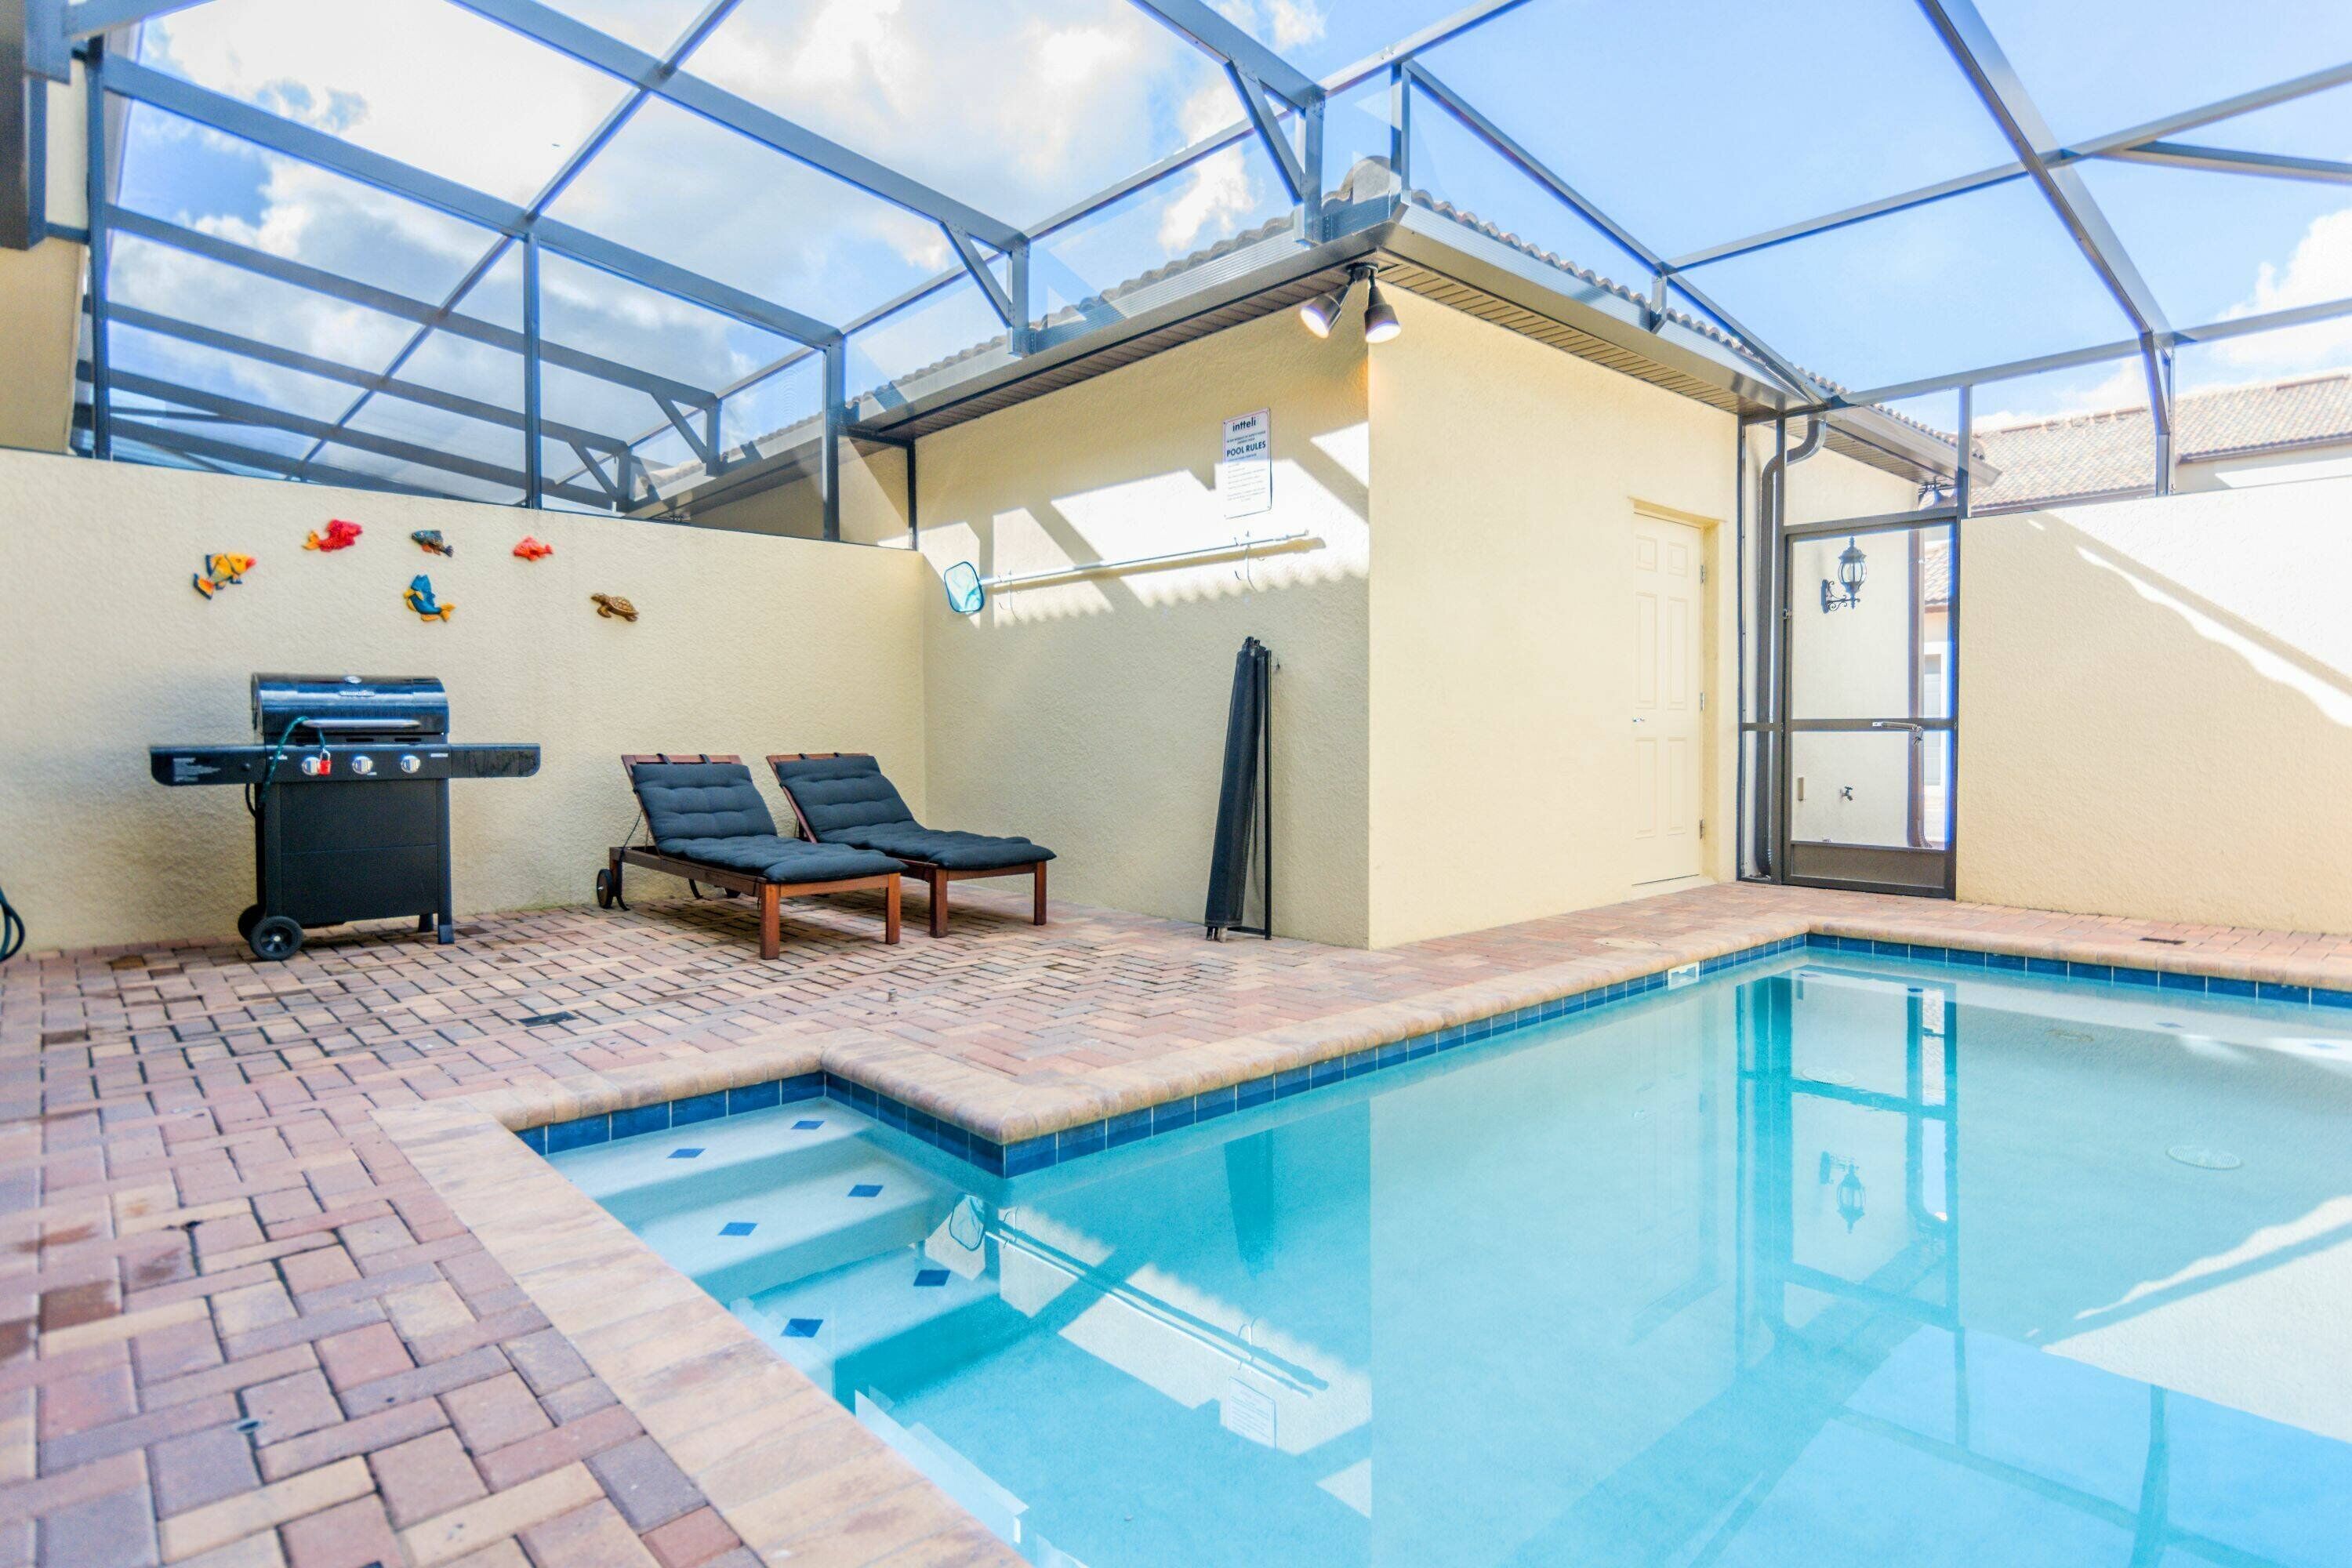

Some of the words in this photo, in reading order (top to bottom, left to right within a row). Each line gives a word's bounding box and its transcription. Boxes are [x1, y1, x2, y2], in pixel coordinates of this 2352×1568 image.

[1232, 417, 1256, 431] intteli
[1226, 447, 1245, 457] POOL
[1246, 441, 1266, 452] RULES
